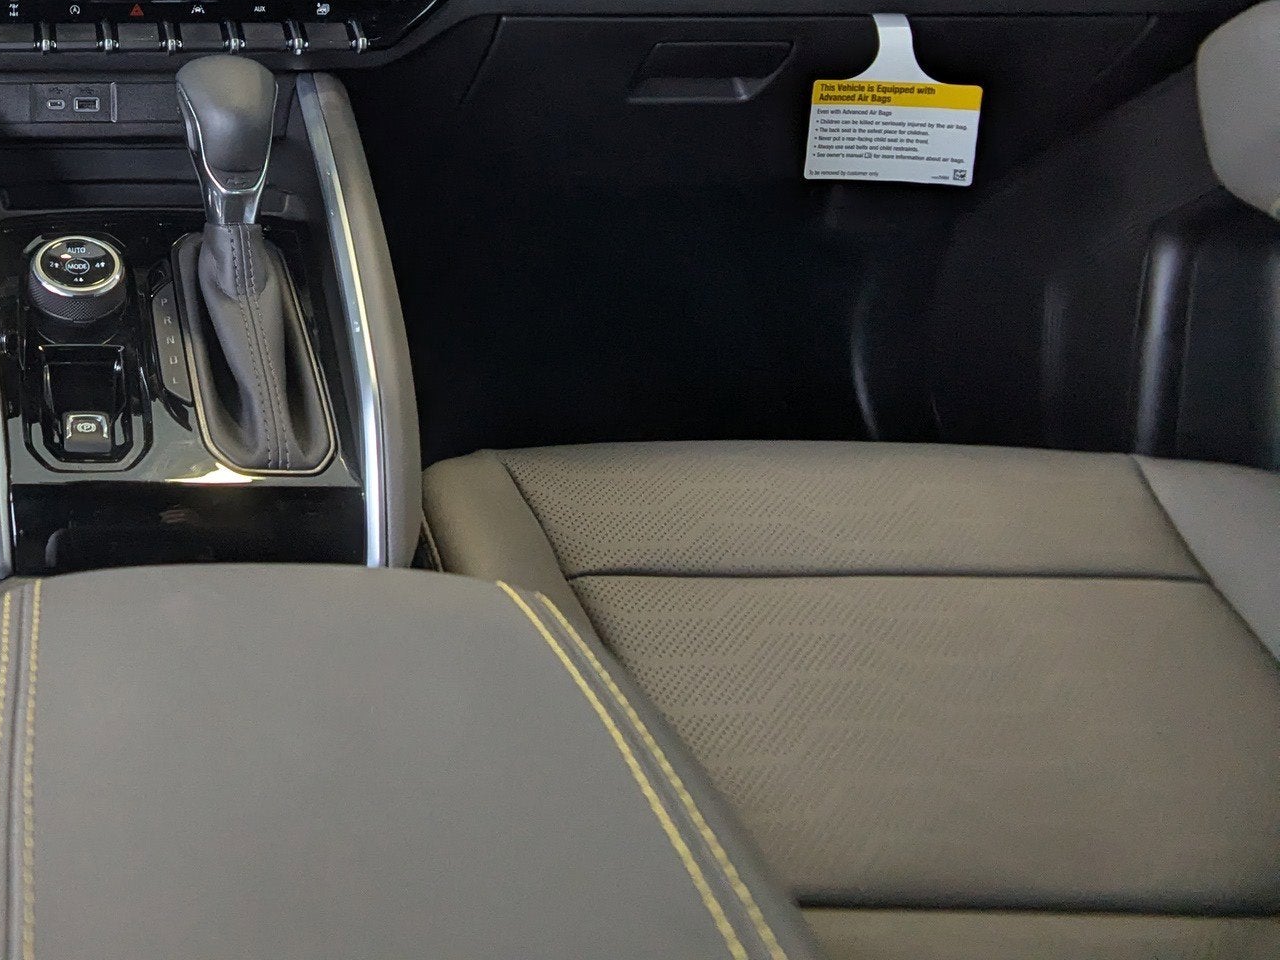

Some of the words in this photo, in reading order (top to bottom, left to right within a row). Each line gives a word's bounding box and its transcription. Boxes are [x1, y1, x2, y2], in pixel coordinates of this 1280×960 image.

[820, 84, 836, 92] This
[838, 84, 865, 92] Vehicle
[868, 84, 874, 92] is
[877, 84, 915, 95] Equipped
[917, 86, 936, 94] with
[819, 93, 856, 102] Advanced
[858, 94, 869, 102] Air
[871, 94, 892, 104] Bags
[161, 298, 167, 306] P
[164, 316, 171, 324] R
[166, 336, 175, 344] N
[170, 356, 178, 364] D
